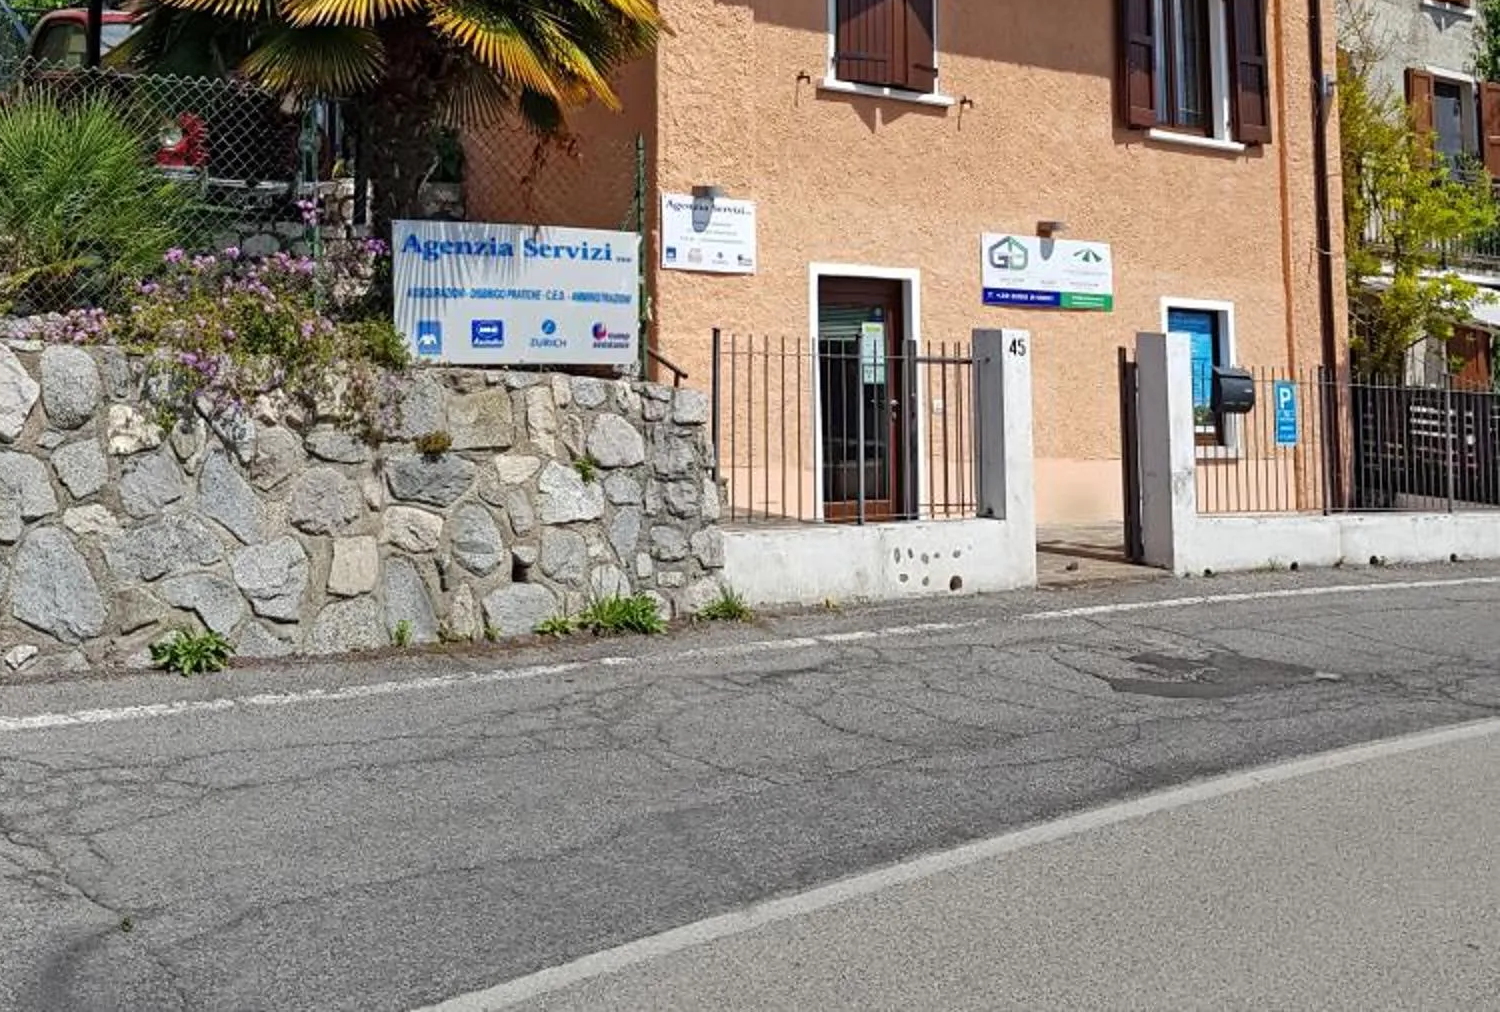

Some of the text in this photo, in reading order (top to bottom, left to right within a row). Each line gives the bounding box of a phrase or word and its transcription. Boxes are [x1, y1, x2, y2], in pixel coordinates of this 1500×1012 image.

[402, 233, 612, 261] Agenzia Servizi
[1009, 338, 1026, 357] 45
[1279, 387, 1292, 409] P
